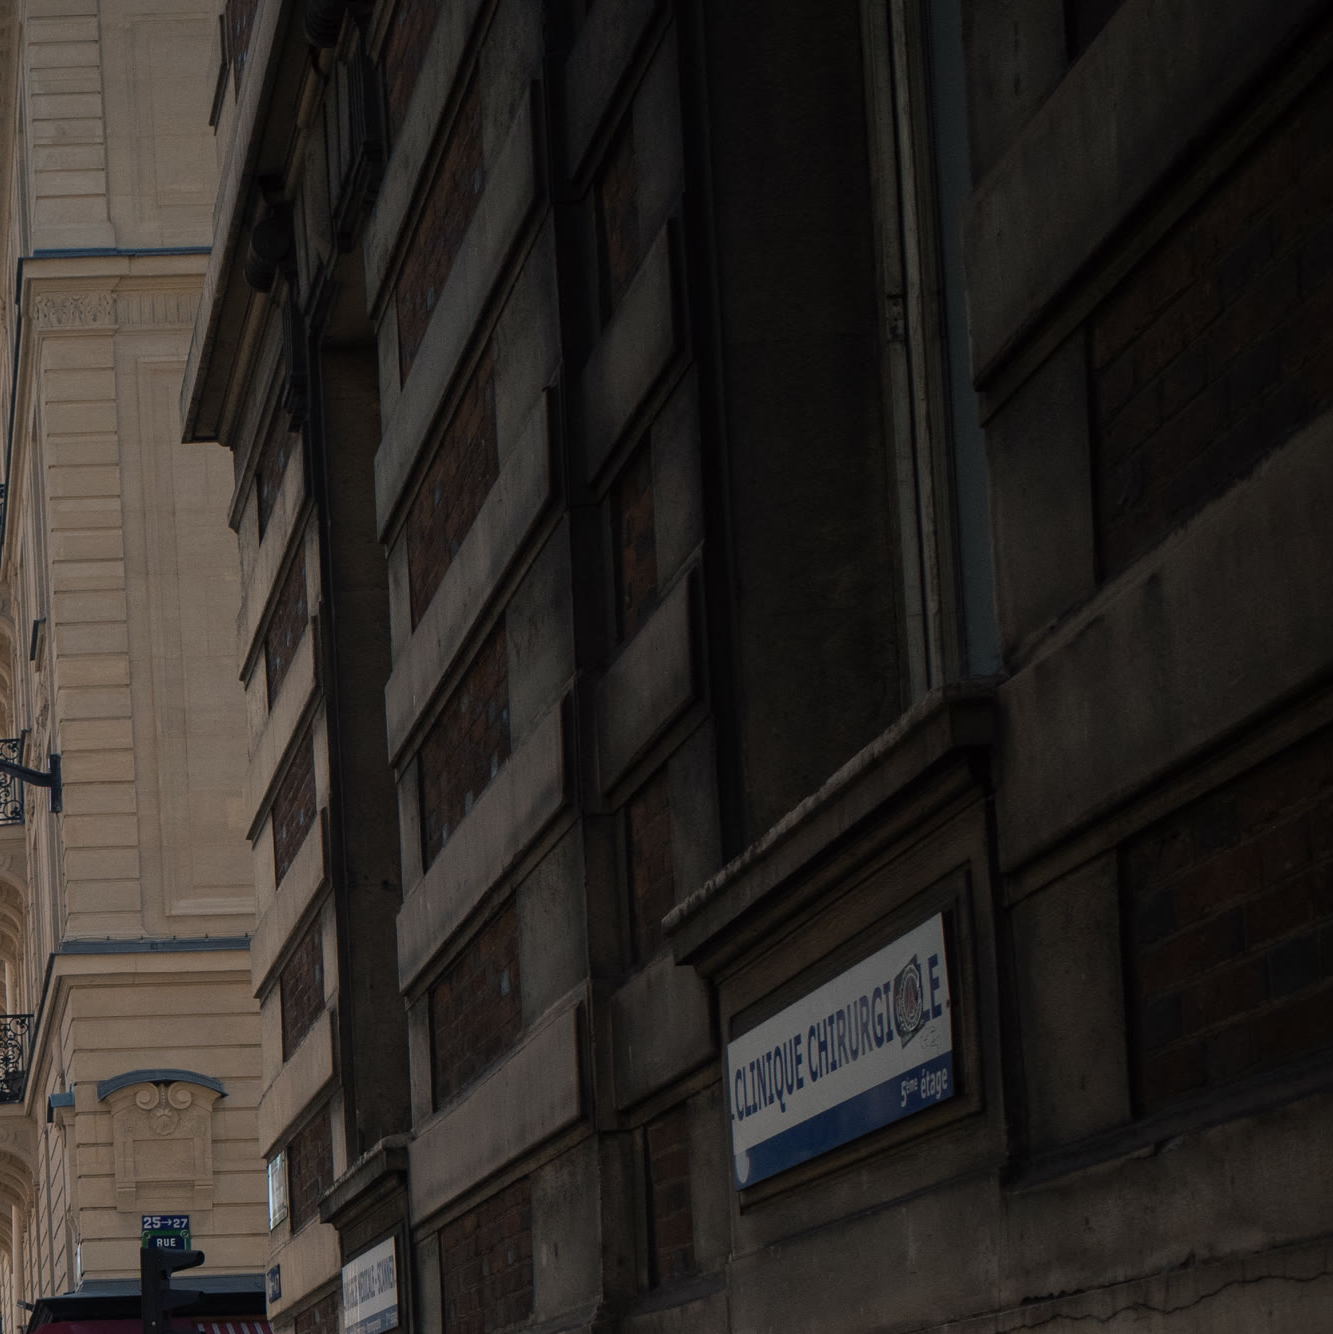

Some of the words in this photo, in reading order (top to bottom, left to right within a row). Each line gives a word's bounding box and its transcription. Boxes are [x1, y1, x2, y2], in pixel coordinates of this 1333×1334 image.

[735, 1033, 804, 1121] CLINIQUE
[808, 954, 942, 1082] CHIRURGILE
[900, 1077, 918, 1107] 5ème
[920, 1067, 948, 1099] étage
[143, 1217, 161, 1229] 25
[173, 1218, 188, 1228] 27
[156, 1238, 176, 1247] RUE
